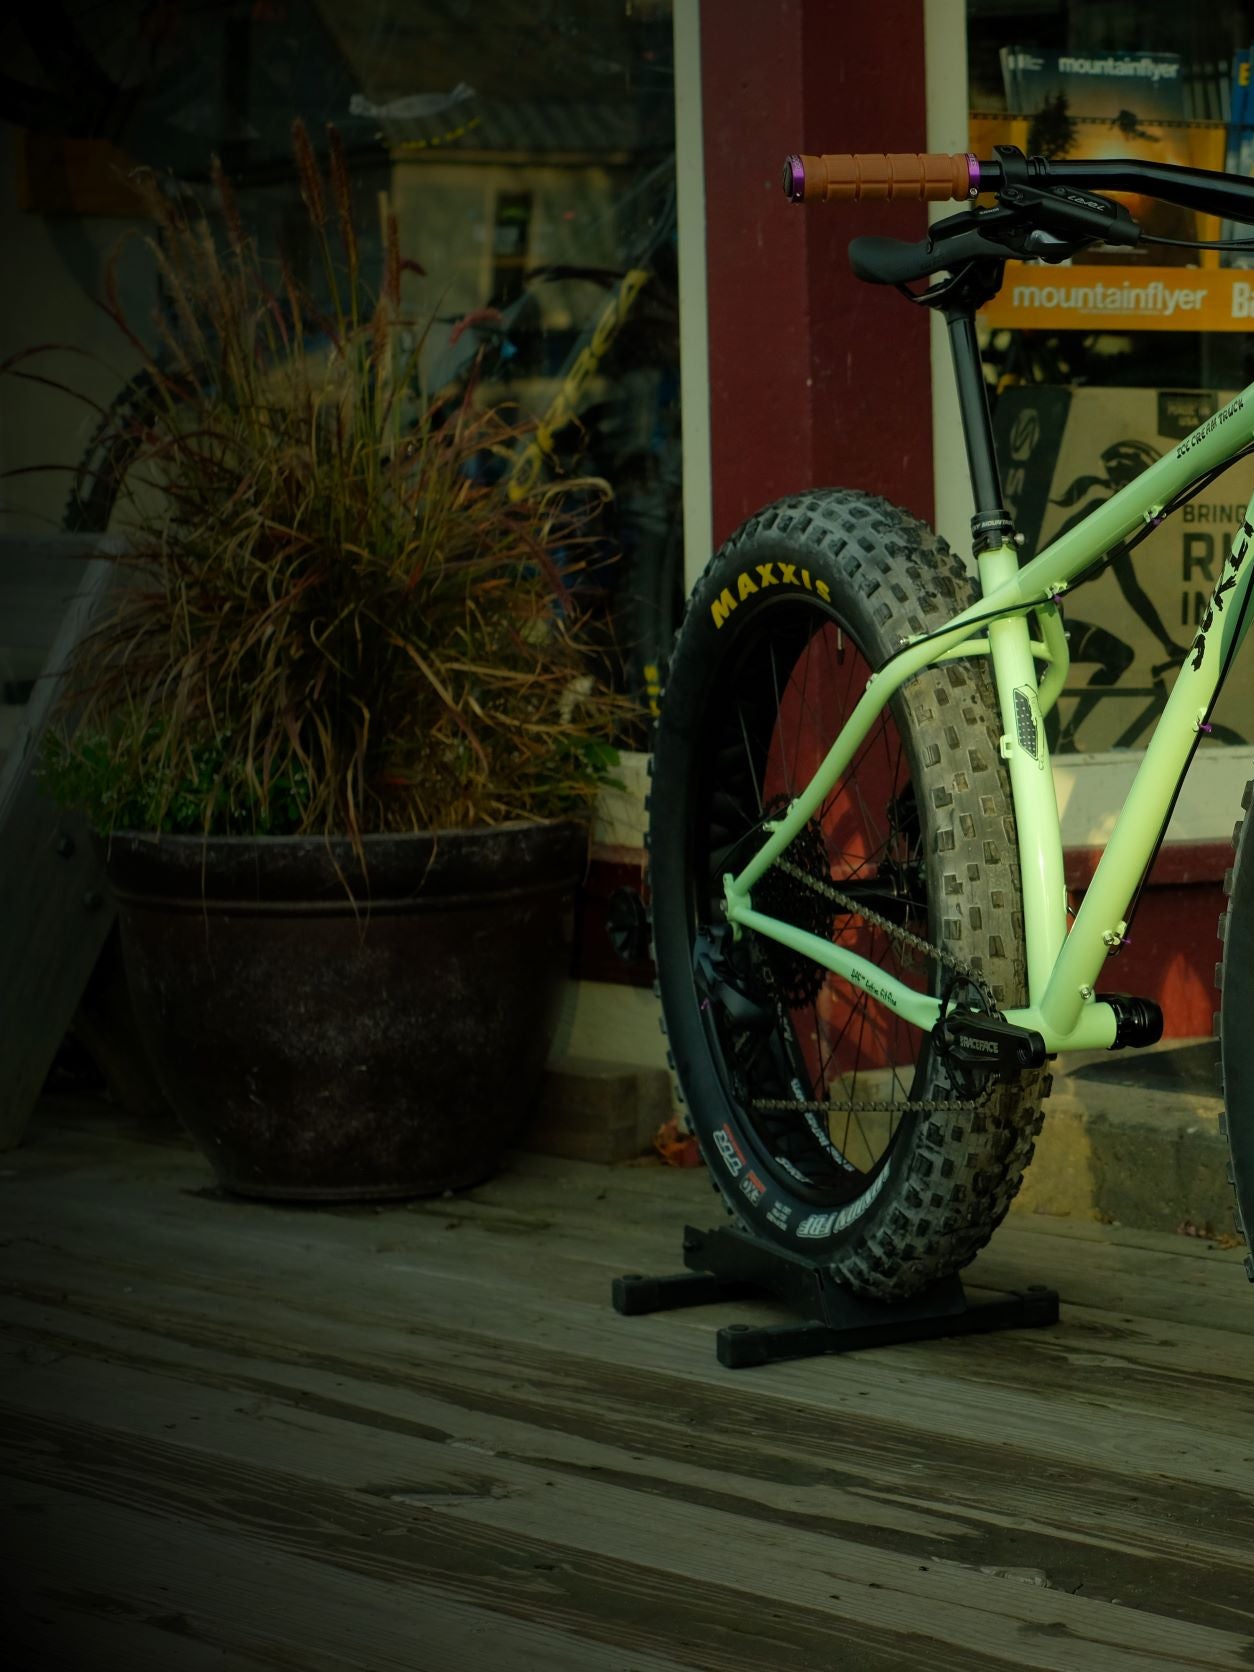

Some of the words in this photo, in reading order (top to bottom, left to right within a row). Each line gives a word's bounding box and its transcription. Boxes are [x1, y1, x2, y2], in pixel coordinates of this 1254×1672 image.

[1058, 57, 1180, 82] mountainflyer
[1012, 281, 1208, 316] mountainflyer
[709, 561, 832, 630] MAXXIS
